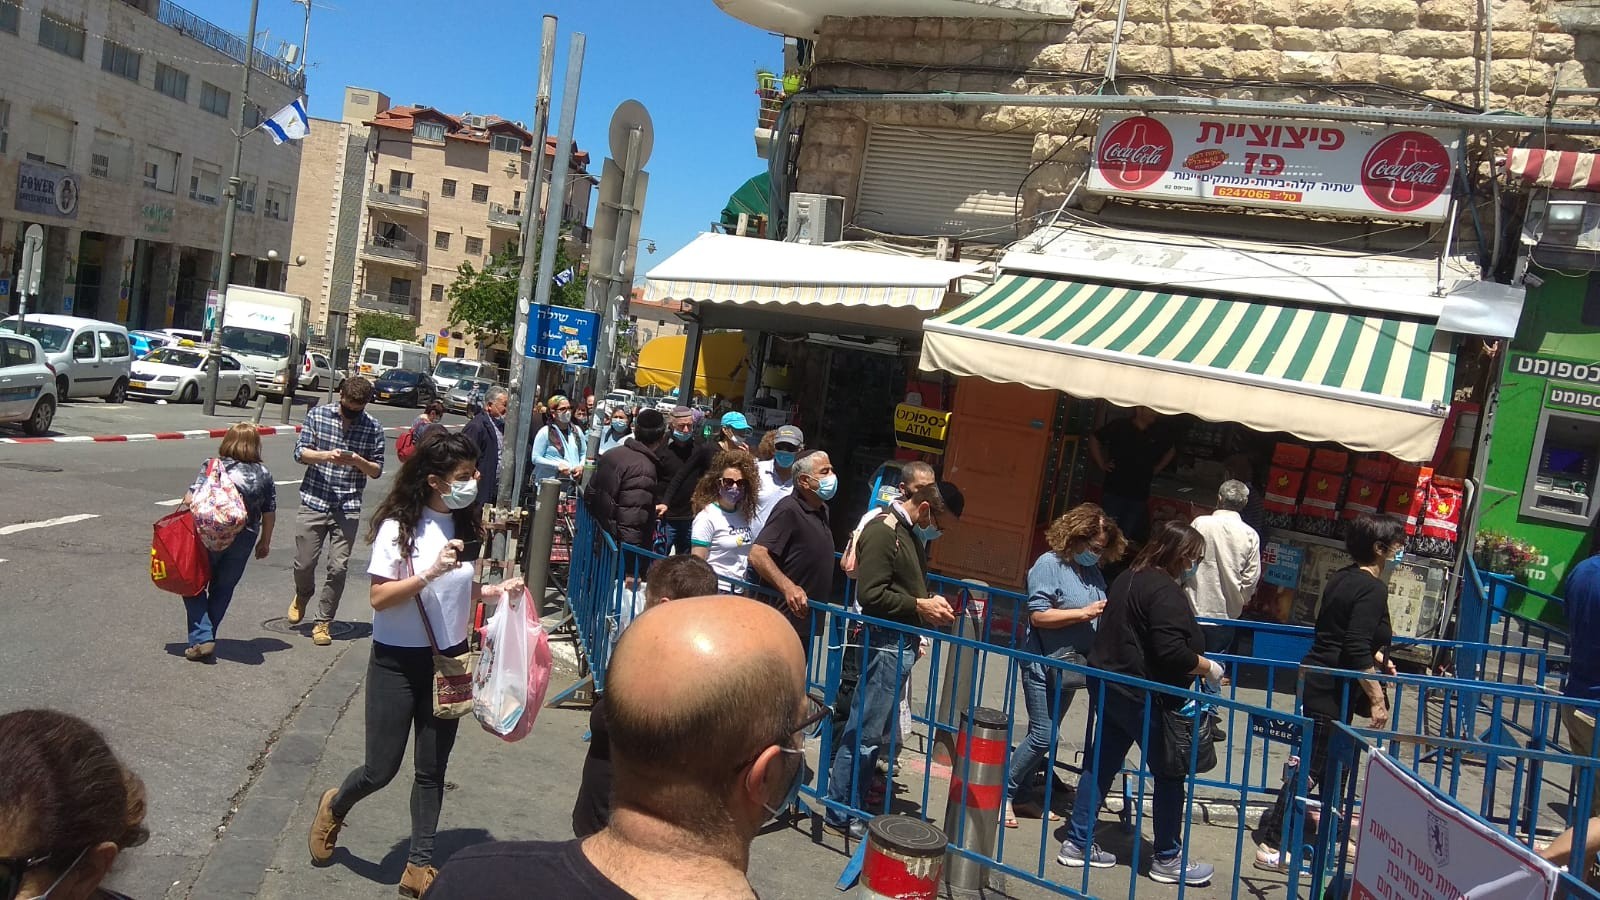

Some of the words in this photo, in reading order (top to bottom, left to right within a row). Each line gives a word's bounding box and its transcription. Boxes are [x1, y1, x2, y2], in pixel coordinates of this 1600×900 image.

[1196, 121, 1345, 151] פיצוציית
[1244, 152, 1286, 176] פז
[20, 175, 55, 194] POWER
[1201, 174, 1251, 186] ממתקים
[1255, 177, 1286, 189] בירות
[1291, 178, 1316, 192] קלה
[1320, 182, 1355, 193] שתיה
[1218, 187, 1271, 200] 6247065
[537, 308, 569, 322] שילה
[1517, 356, 1600, 382] כספומט
[896, 408, 947, 428] כספומט
[905, 423, 932, 437] ATM
[1369, 818, 1404, 860] הבריאות
[1406, 848, 1434, 883] משרד
